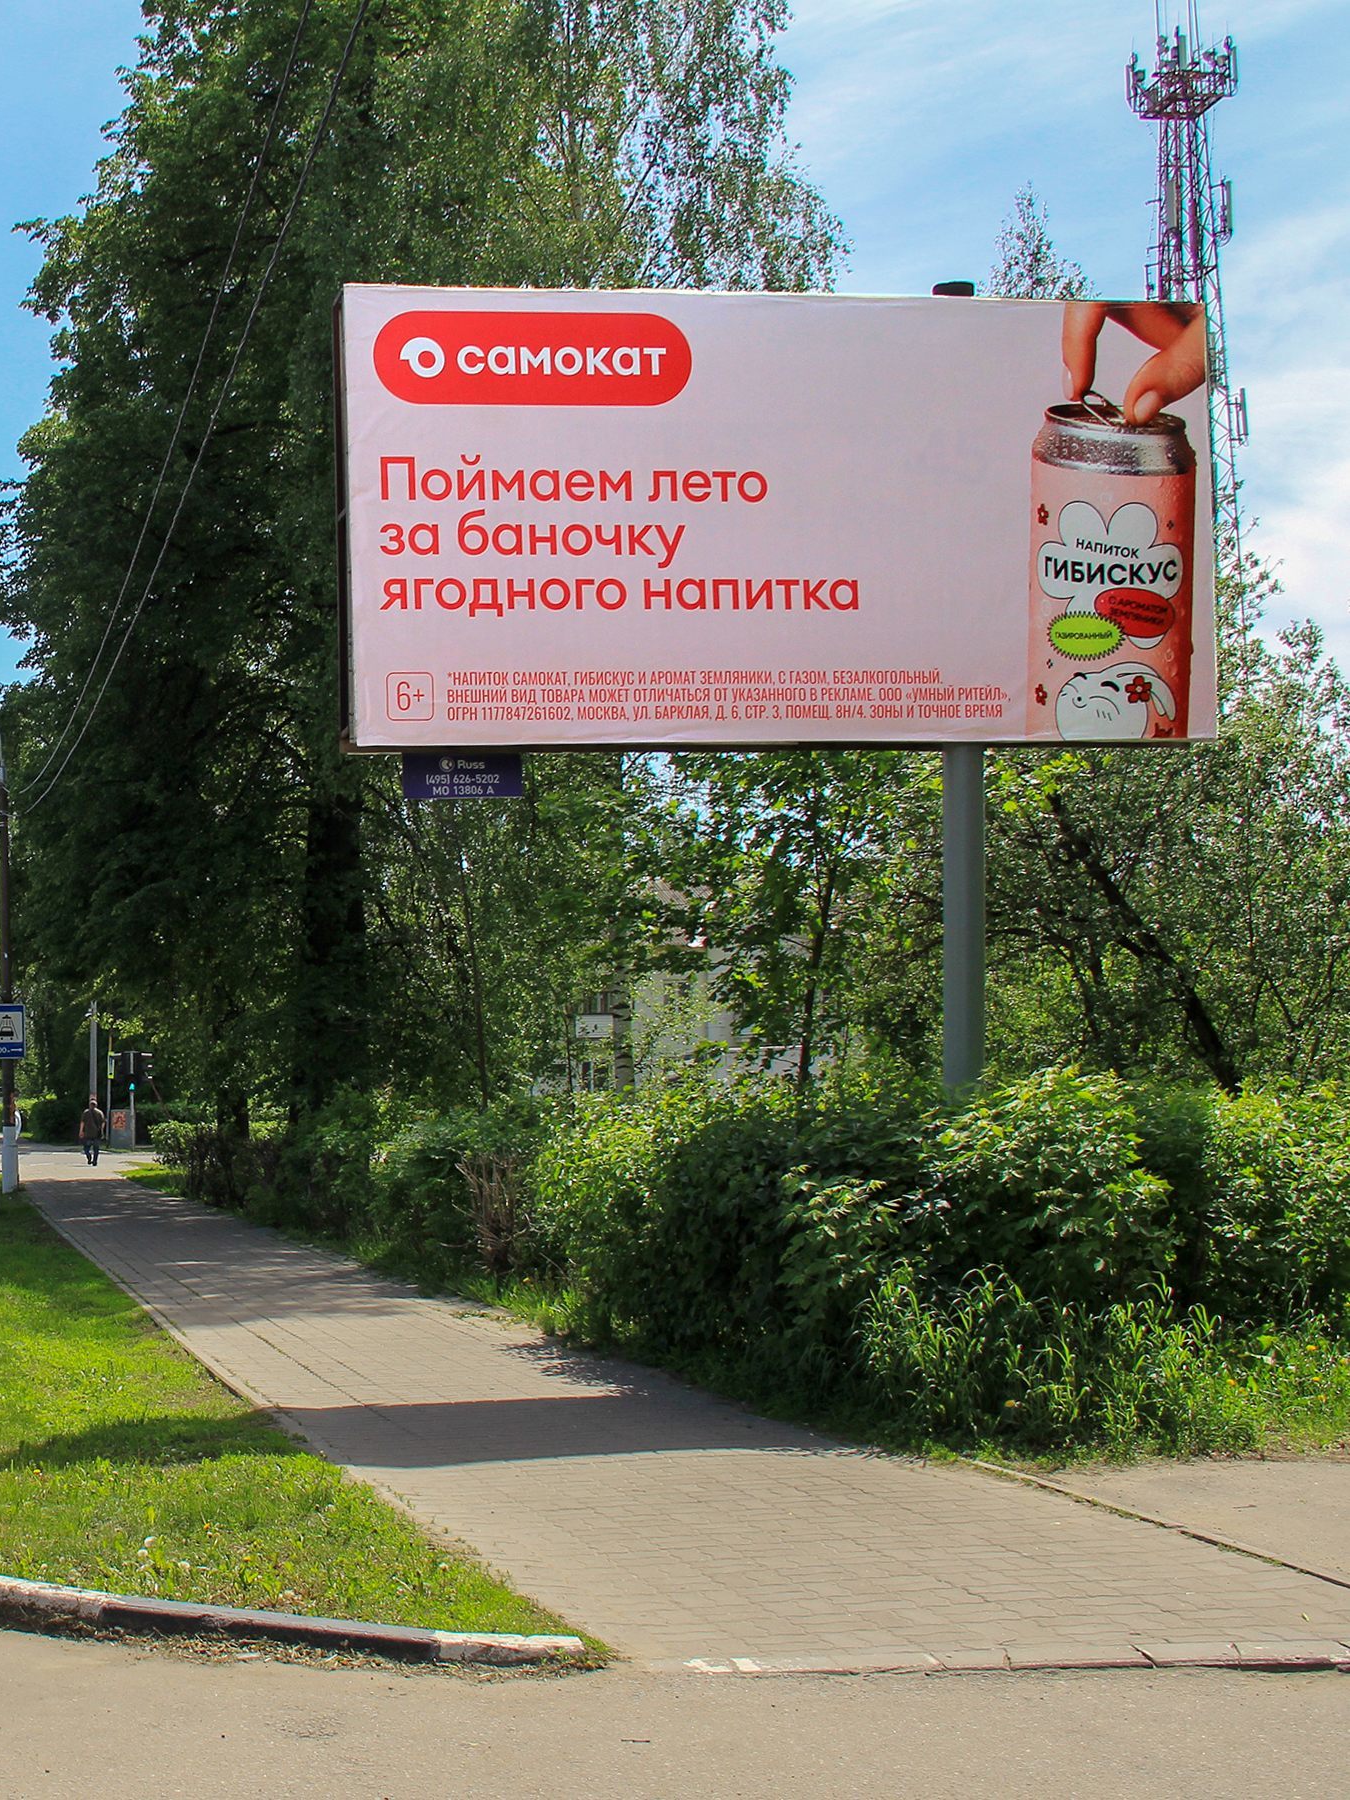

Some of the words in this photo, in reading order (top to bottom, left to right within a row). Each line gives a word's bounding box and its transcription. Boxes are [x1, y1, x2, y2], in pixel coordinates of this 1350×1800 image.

[456, 343, 667, 377] самокат
[379, 453, 633, 502] Поймаем
[648, 469, 768, 503] лето
[379, 522, 439, 556] за
[456, 509, 686, 569] баночку
[1075, 538, 1140, 559] НАПИТОК
[1044, 556, 1178, 586] ГИБИСКУС
[379, 576, 627, 618] ягодного
[644, 577, 861, 611] напитка
[512, 671, 570, 687] САМОКАТ,
[573, 671, 634, 687] ГИБИСКУС
[638, 671, 646, 685] И
[650, 671, 696, 685] АРОМАТ
[700, 671, 775, 686] ЗЕМЛЯНИКИ,
[778, 670, 786, 685] С
[789, 670, 830, 685] ГАЗОМ,
[833, 668, 943, 685] БЕЗАЛКОГОЛЬНЫЙ.
[396, 681, 425, 713] 6+
[447, 687, 507, 703] ВНЕШНИЙ
[511, 689, 537, 705] ВИД
[541, 689, 585, 703] ТОВАРА
[589, 689, 629, 703] МОЖЕТ
[633, 688, 710, 702] ОТЛИЧАТЬСЯ
[714, 688, 728, 702] ОТ
[731, 688, 806, 703] УКАЗАННОГО
[810, 688, 817, 702] В
[821, 687, 875, 702] РЕКЛАМЕ.
[879, 687, 902, 702] ООО
[905, 685, 954, 703] «УМНЫЙ
[447, 706, 478, 721] ОГРН
[577, 706, 629, 721] МОСКВА,
[633, 706, 650, 721] УЛ.
[654, 706, 712, 721] БАРКЛАЯ,
[715, 705, 727, 721] Д.
[731, 705, 741, 720] 6,
[745, 705, 768, 719] СТР.
[772, 705, 782, 720] 3,
[785, 705, 832, 720] ПОМЕЩ.
[870, 704, 903, 718] ЗОНЫ
[906, 704, 914, 718] И
[917, 704, 961, 718] ТОЧНОЕ
[965, 704, 1002, 718] ВРЕМЯ
[457, 760, 485, 769] Russ
[425, 774, 450, 785] (495)
[453, 774, 500, 784] 626-5202
[453, 786, 483, 795] 13806
